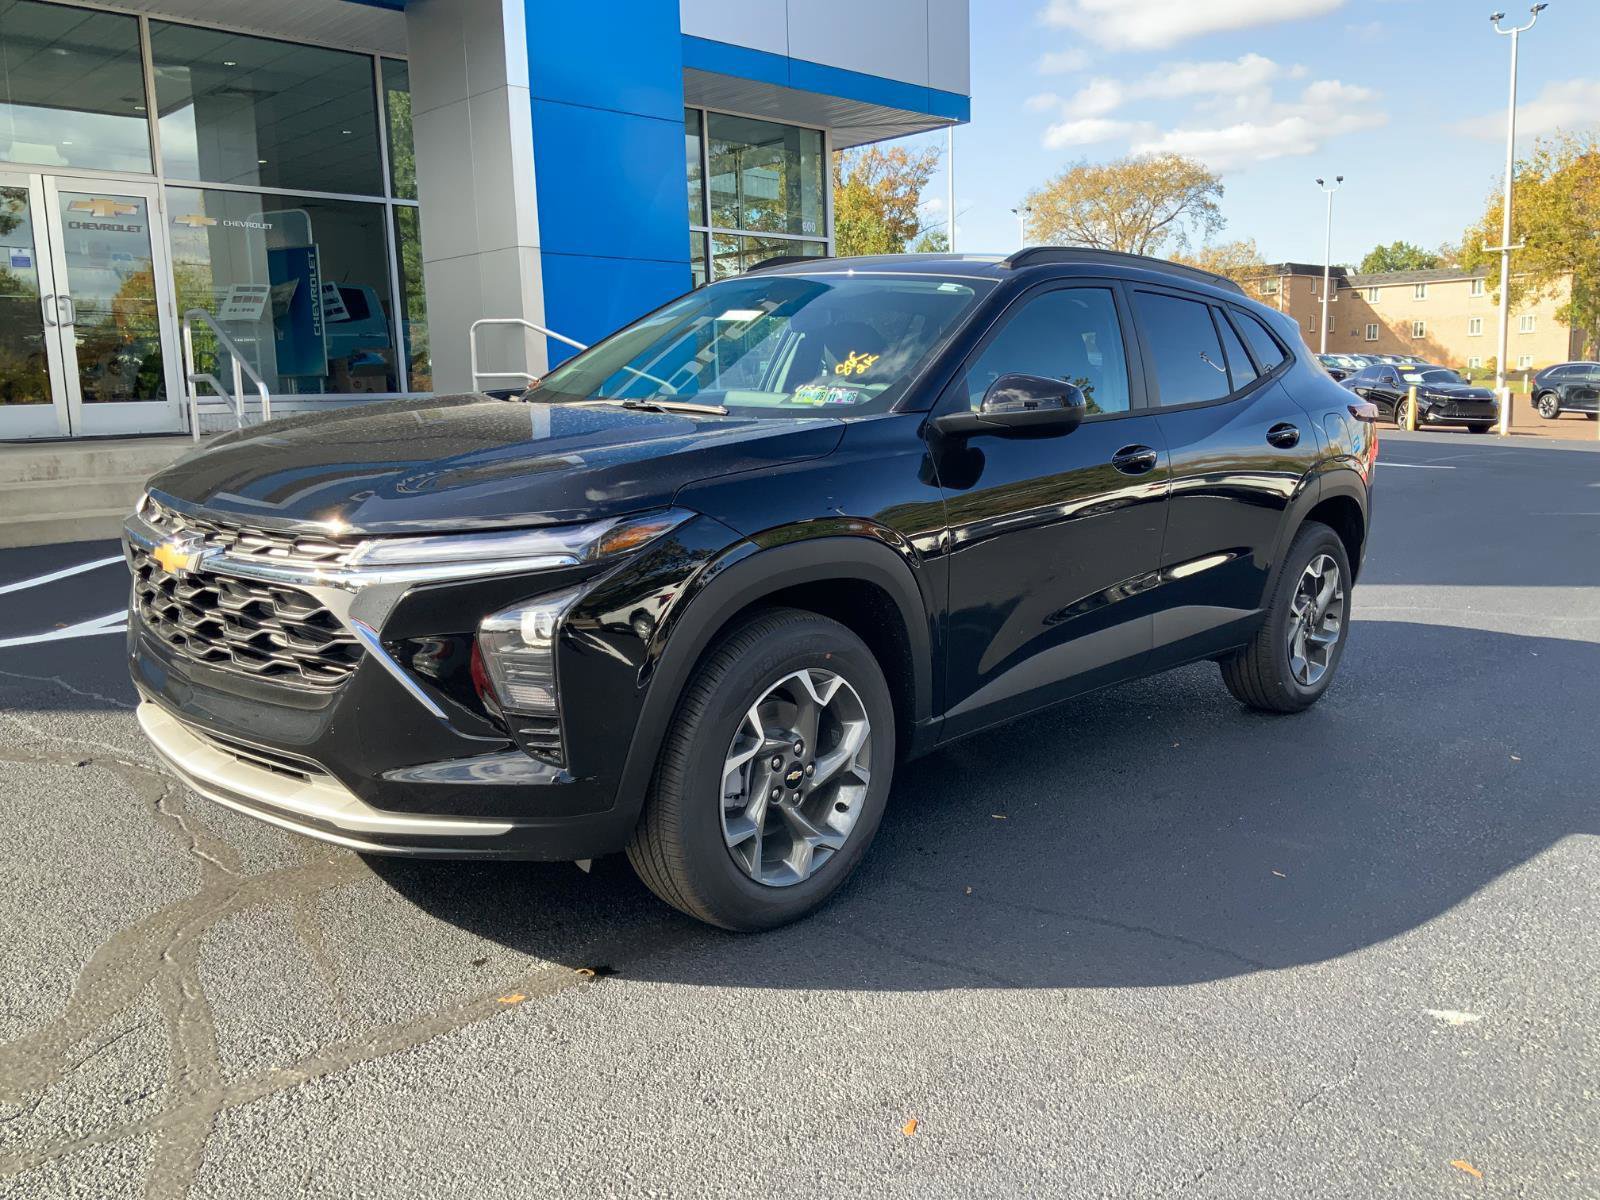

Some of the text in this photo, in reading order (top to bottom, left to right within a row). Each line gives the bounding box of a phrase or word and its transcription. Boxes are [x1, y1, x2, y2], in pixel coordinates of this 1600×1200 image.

[68, 221, 143, 233] CHEVROLET
[223, 220, 272, 230] CHEVROLET
[307, 251, 321, 336] CHEVROLET
